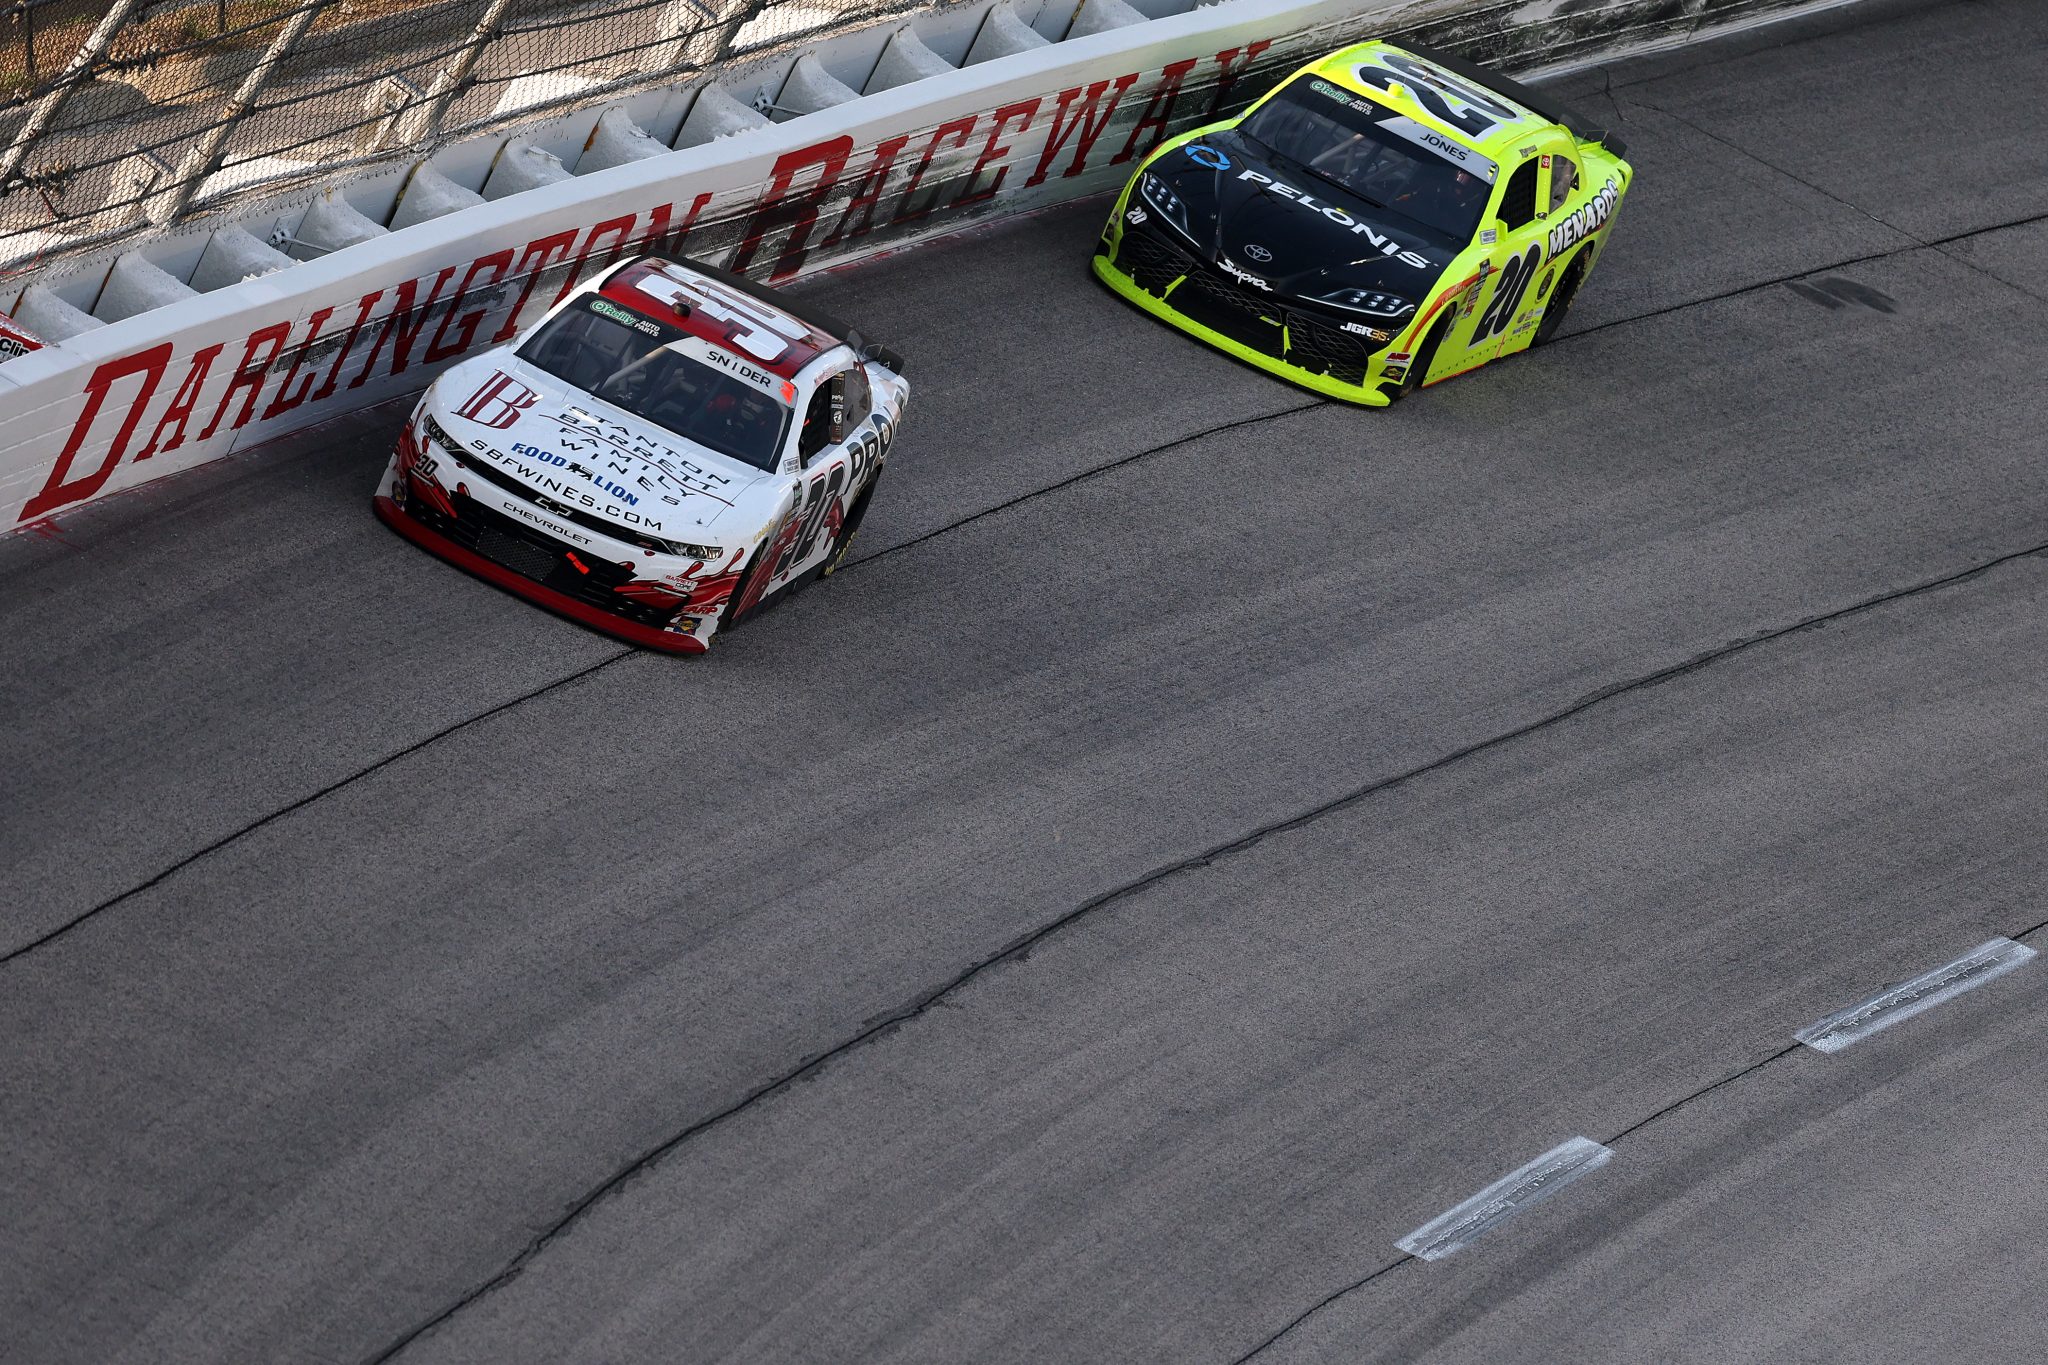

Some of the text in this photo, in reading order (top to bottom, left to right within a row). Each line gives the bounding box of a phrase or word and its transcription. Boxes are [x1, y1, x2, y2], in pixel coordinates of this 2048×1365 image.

[1349, 102, 1372, 116] PARTS
[1354, 53, 1519, 141] 20
[1354, 99, 1373, 110] AUTO
[1420, 133, 1468, 161] JONES
[1126, 206, 1148, 225] 20
[1236, 169, 1431, 269] PELONIS
[1547, 178, 1619, 263] MENARDS
[18, 38, 1273, 522] DARLINGTON RACEWAY
[1217, 258, 1274, 292] Supra
[1468, 241, 1542, 348] 20
[634, 323, 659, 338] PARTS
[639, 319, 661, 332] AUTO
[706, 350, 772, 388] SNIDER
[414, 452, 440, 479] 30
[510, 442, 640, 507] FOOD LION
[558, 413, 718, 492] BARRETT
[559, 427, 697, 497] FAMILY
[560, 438, 681, 506] WINES
[571, 405, 731, 486] STANTON
[470, 439, 663, 532] SBFWINES.COM
[503, 501, 592, 545] CHEVROLET
